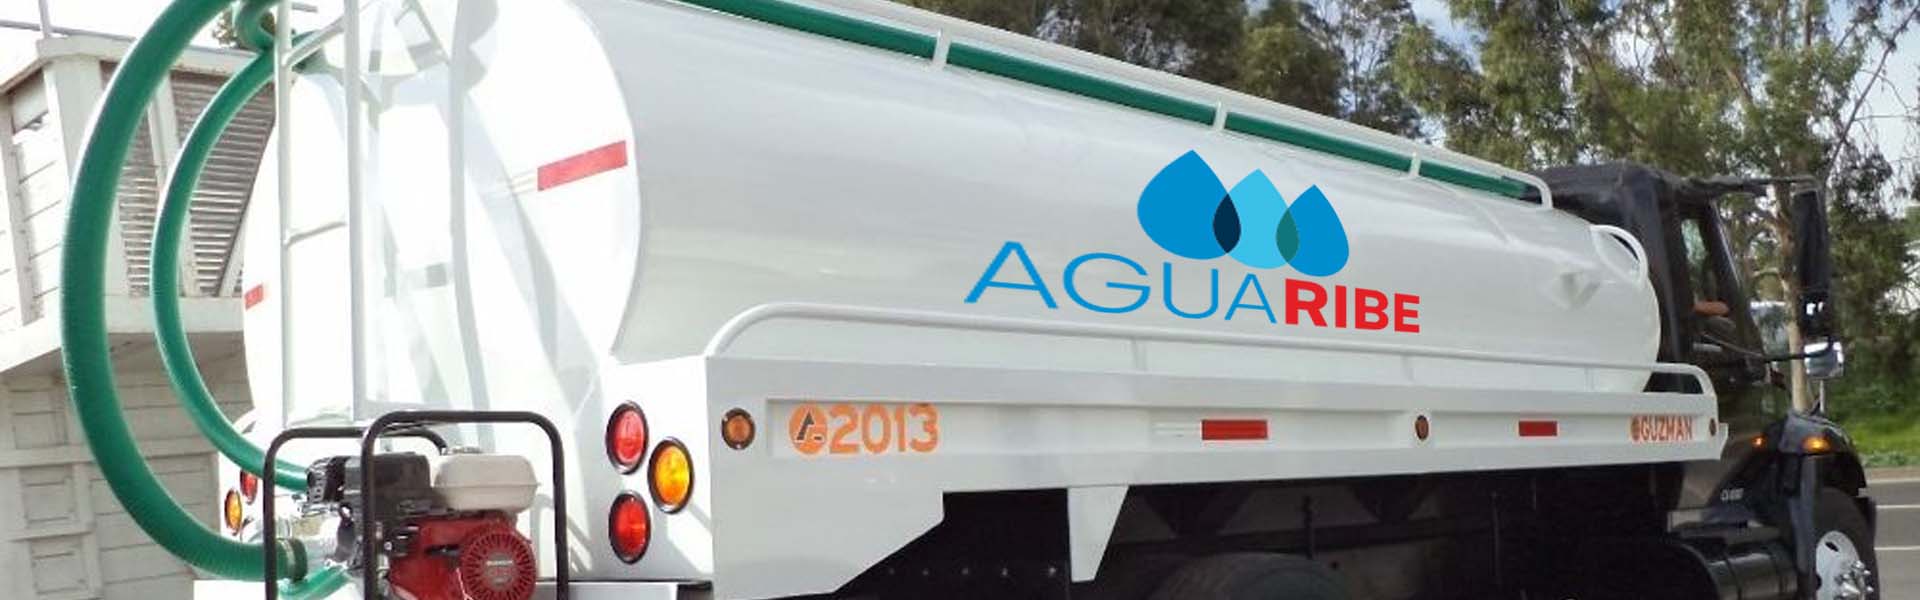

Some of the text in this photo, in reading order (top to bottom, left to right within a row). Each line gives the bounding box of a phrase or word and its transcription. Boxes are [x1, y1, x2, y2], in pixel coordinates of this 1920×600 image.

[964, 241, 1420, 333] AGUARIBE
[829, 403, 939, 454] 2013
[1641, 415, 1692, 441] GUZMAN
